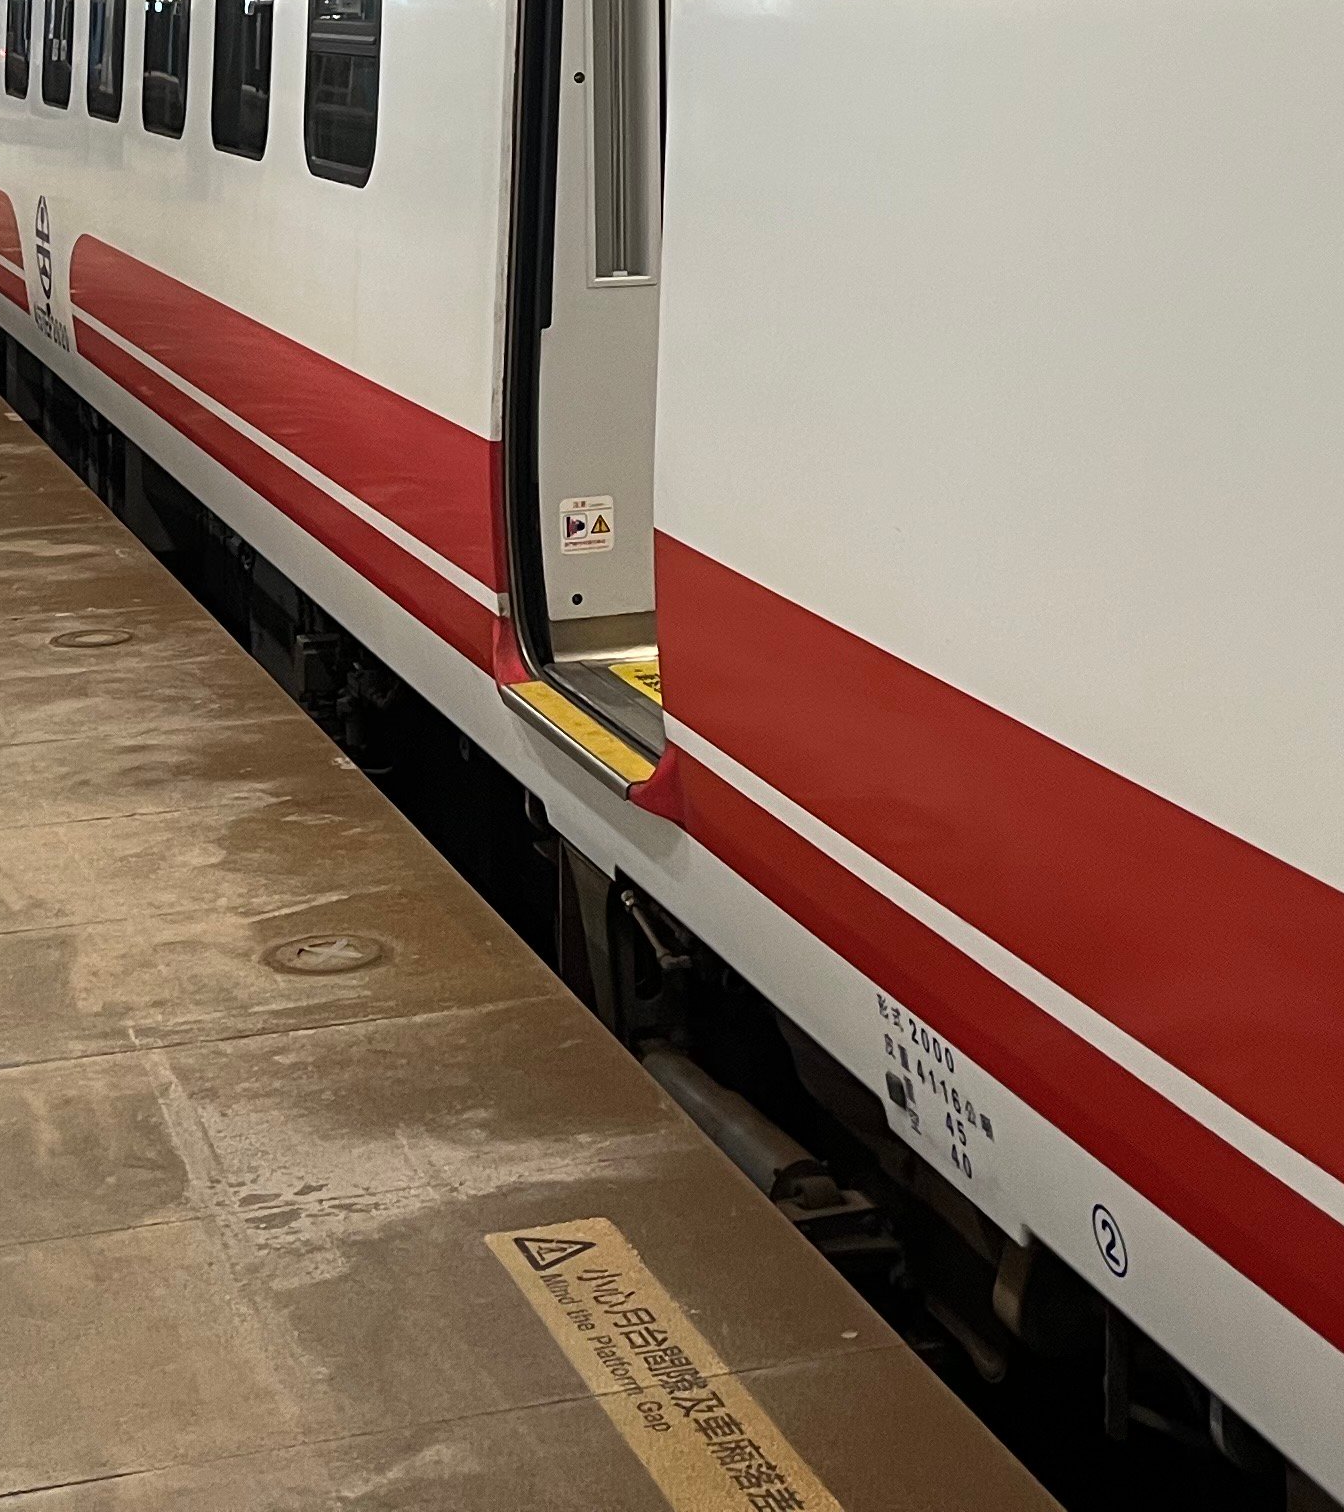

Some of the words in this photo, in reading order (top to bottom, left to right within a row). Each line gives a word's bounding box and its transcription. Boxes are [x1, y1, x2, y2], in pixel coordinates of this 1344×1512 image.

[908, 1018, 955, 1074] 2000
[945, 1111, 967, 1147] 45
[951, 1144, 973, 1180] 40
[539, 1273, 583, 1306] Mind
[566, 1308, 596, 1332] the
[586, 1334, 645, 1397] Platform
[636, 1400, 672, 1433] Gap
